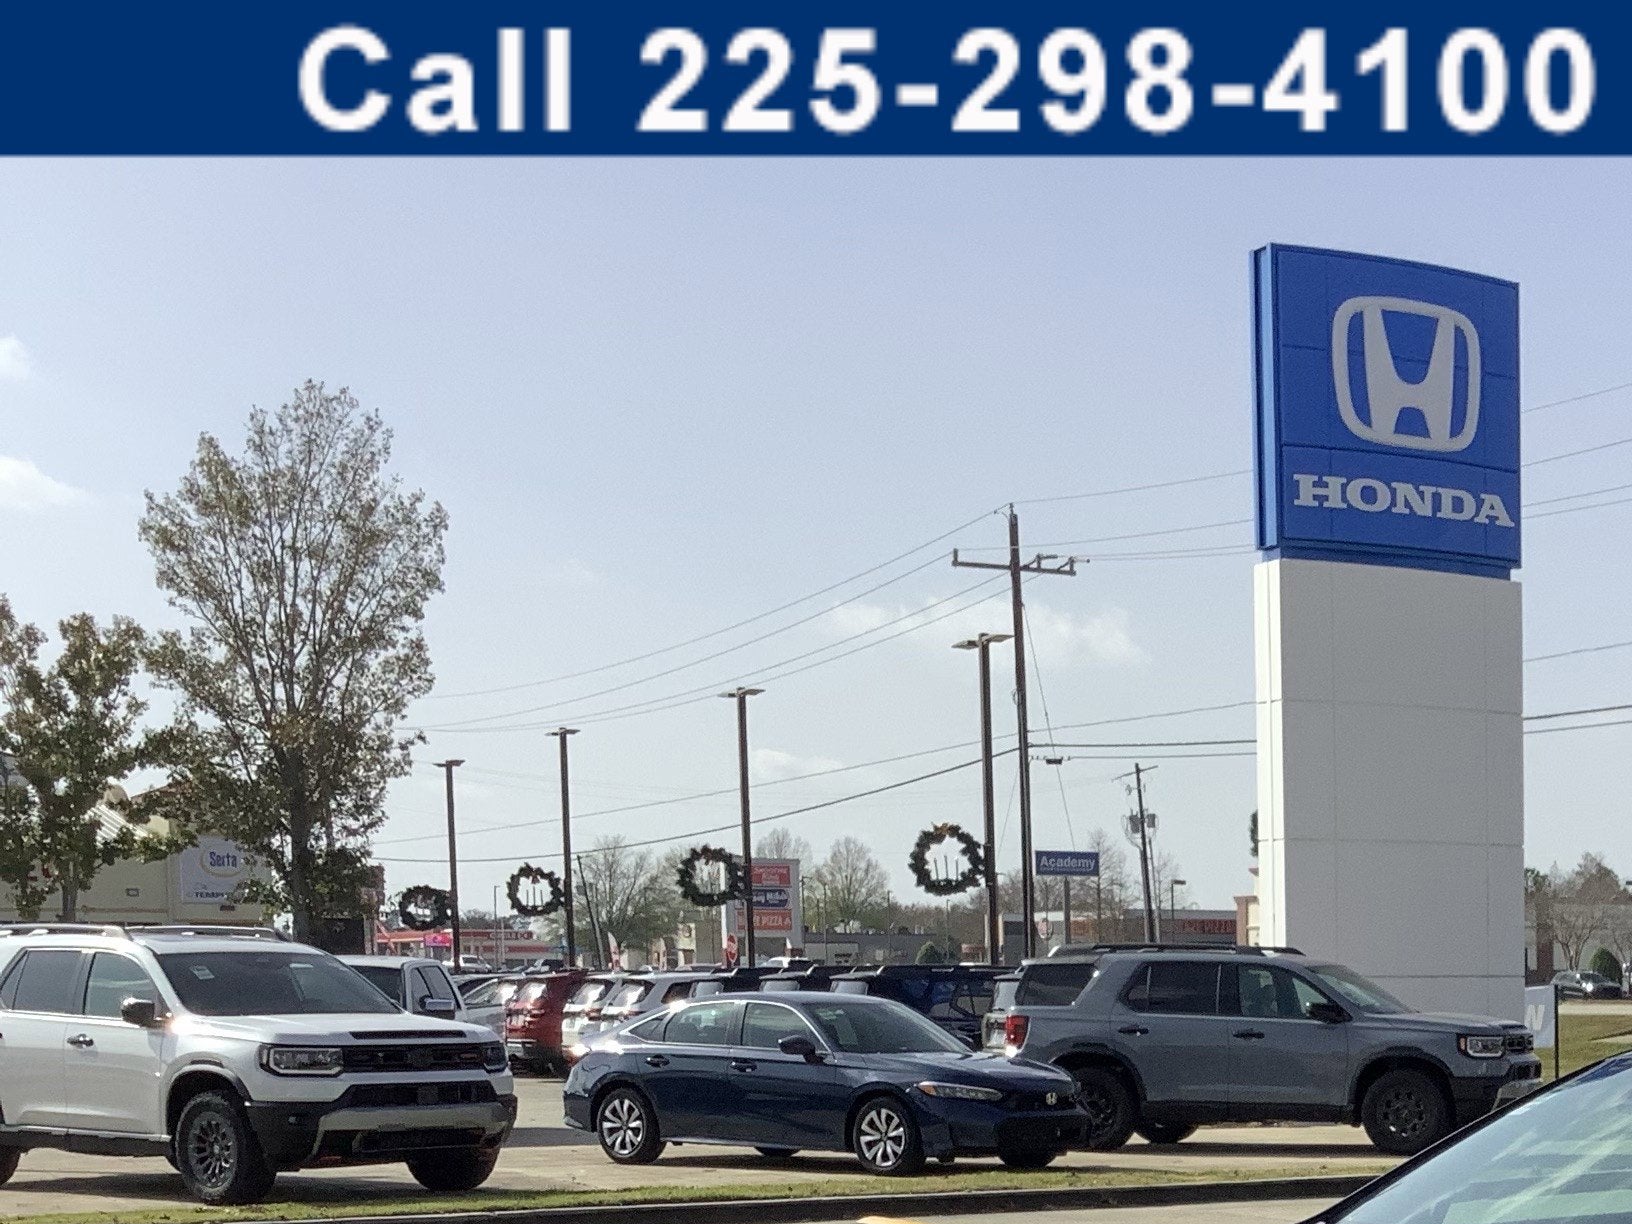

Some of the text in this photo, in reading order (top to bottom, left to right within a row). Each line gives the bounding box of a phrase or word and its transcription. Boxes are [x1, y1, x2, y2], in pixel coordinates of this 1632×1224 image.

[1293, 473, 1515, 528] HONDA
[209, 851, 237, 868] Serta
[1040, 855, 1096, 871] Academy
